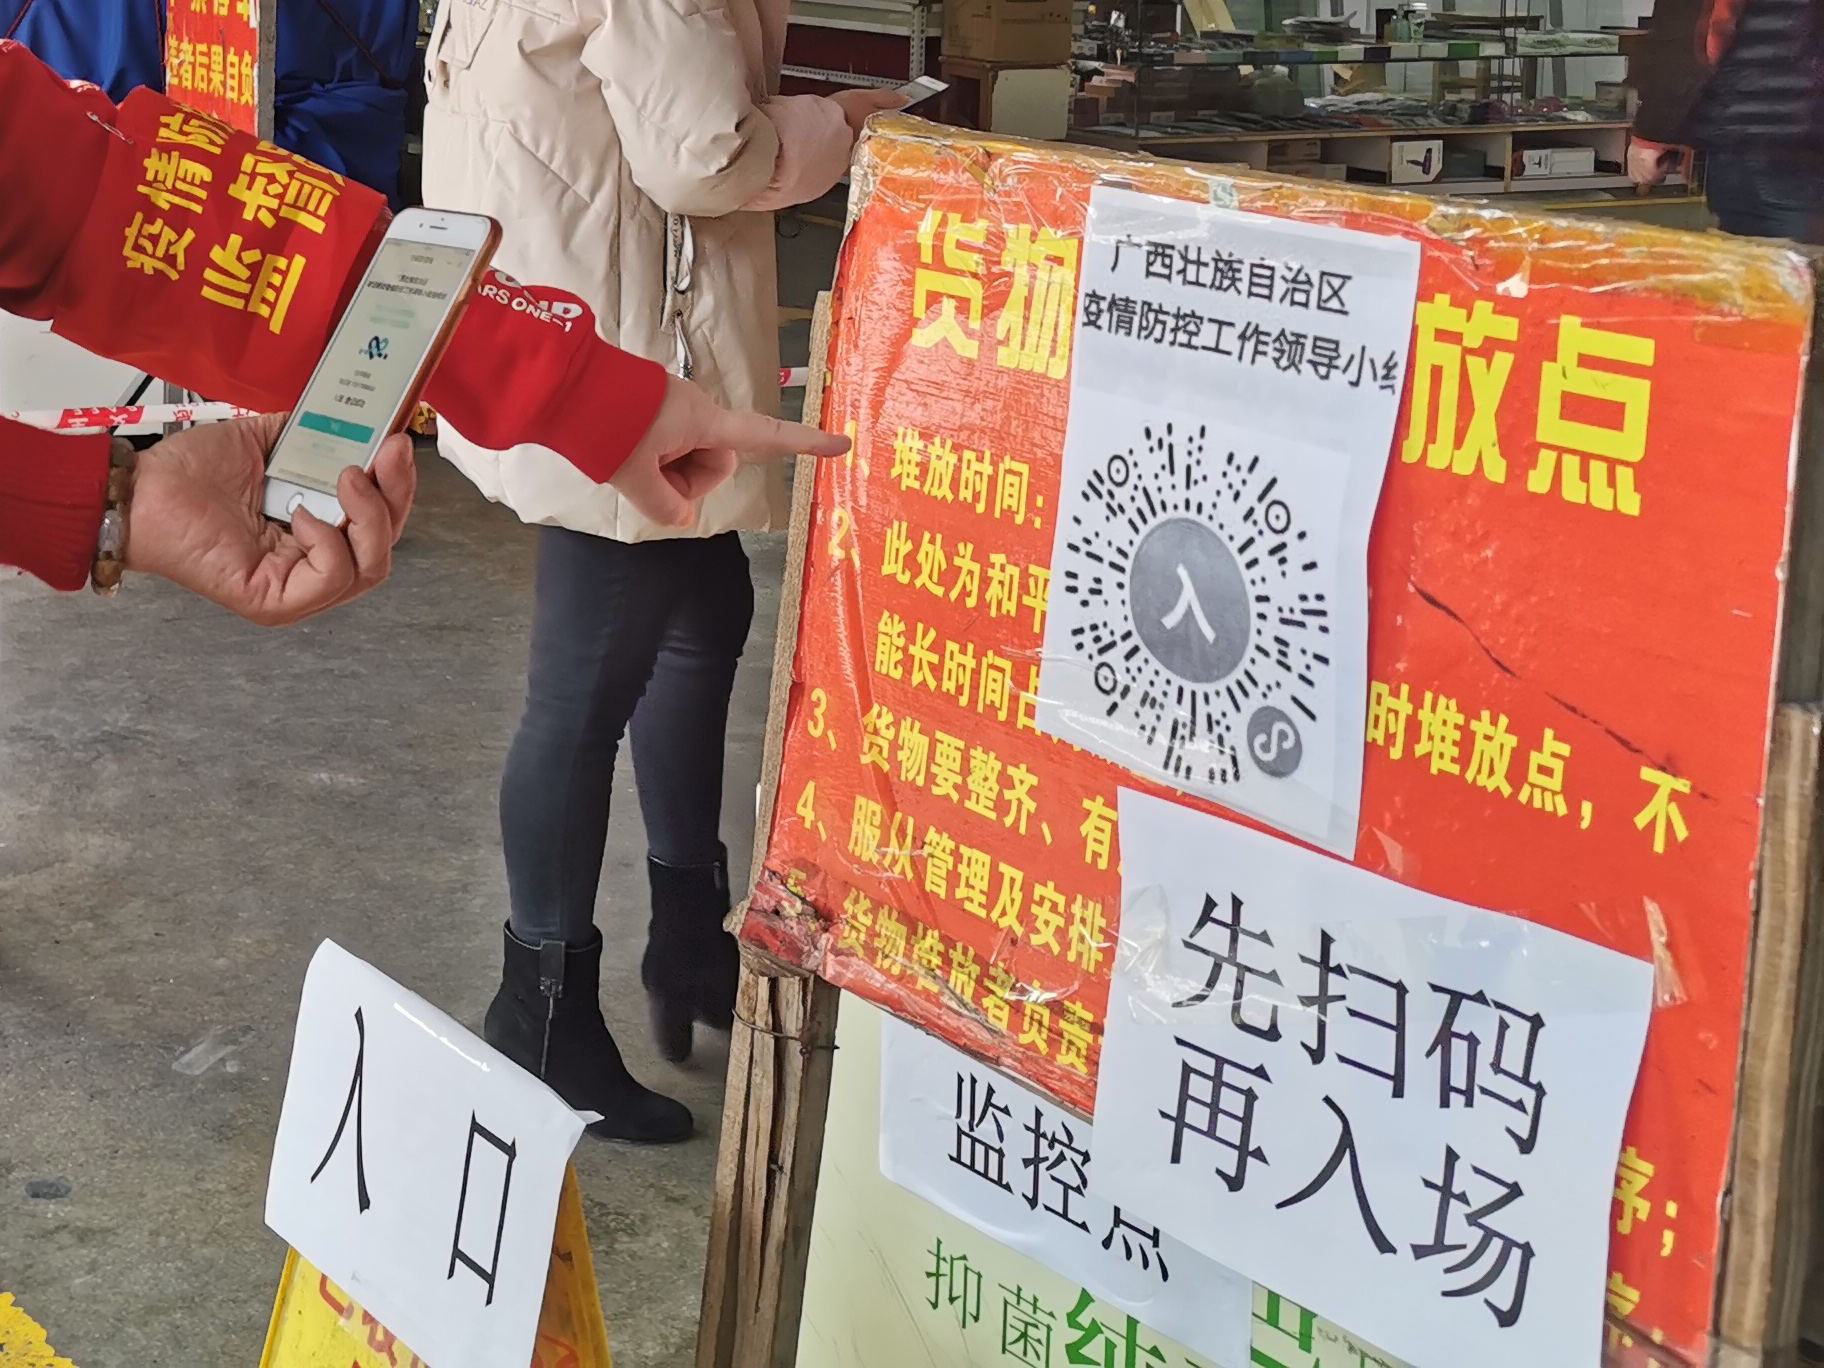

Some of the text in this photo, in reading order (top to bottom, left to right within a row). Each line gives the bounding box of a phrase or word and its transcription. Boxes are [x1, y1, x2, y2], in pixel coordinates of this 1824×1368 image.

[122, 104, 236, 282] 疫情防
[1109, 234, 1353, 317] 广西壮族自治区
[1401, 293, 1656, 517] 放点
[881, 519, 1051, 635] 此处为和平
[846, 794, 1109, 975] 服从管理及安排
[1171, 891, 1547, 1155] 先扫码
[1157, 1035, 1537, 1329] 再入场
[924, 1237, 1057, 1368] 抑菌
